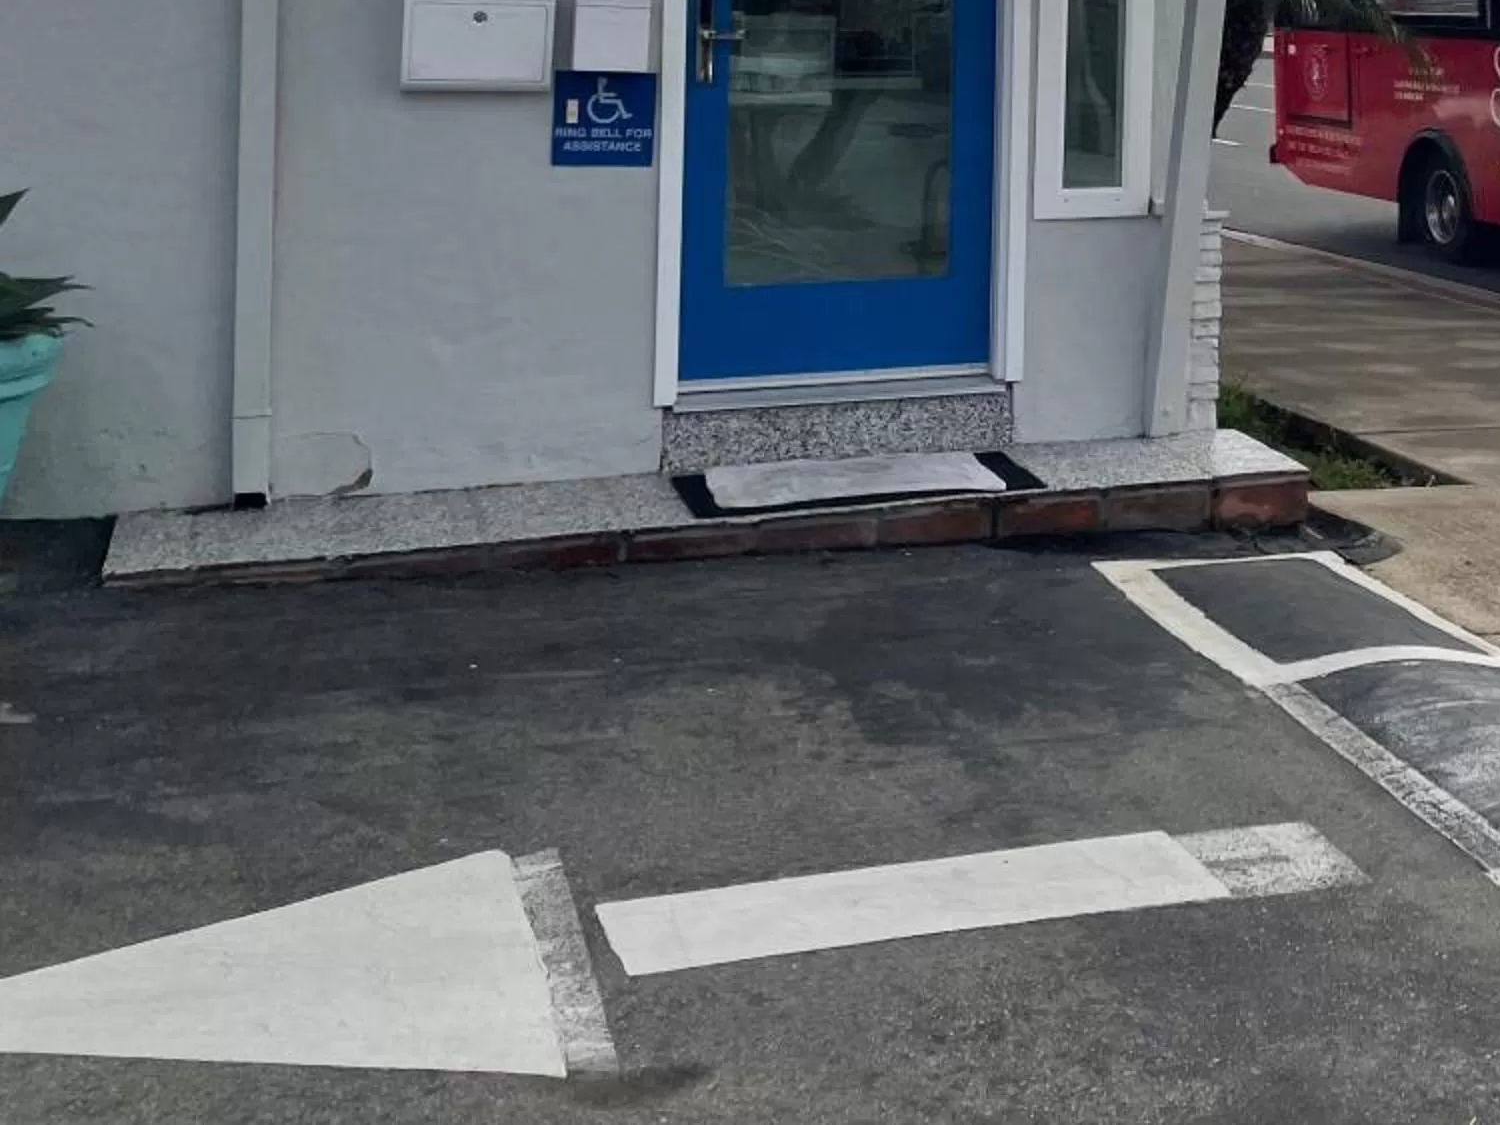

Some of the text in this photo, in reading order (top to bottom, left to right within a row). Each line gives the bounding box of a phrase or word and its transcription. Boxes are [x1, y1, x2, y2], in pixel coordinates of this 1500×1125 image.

[555, 126, 653, 139] RING BELL FOR
[563, 140, 642, 152] ASSISTANCE
